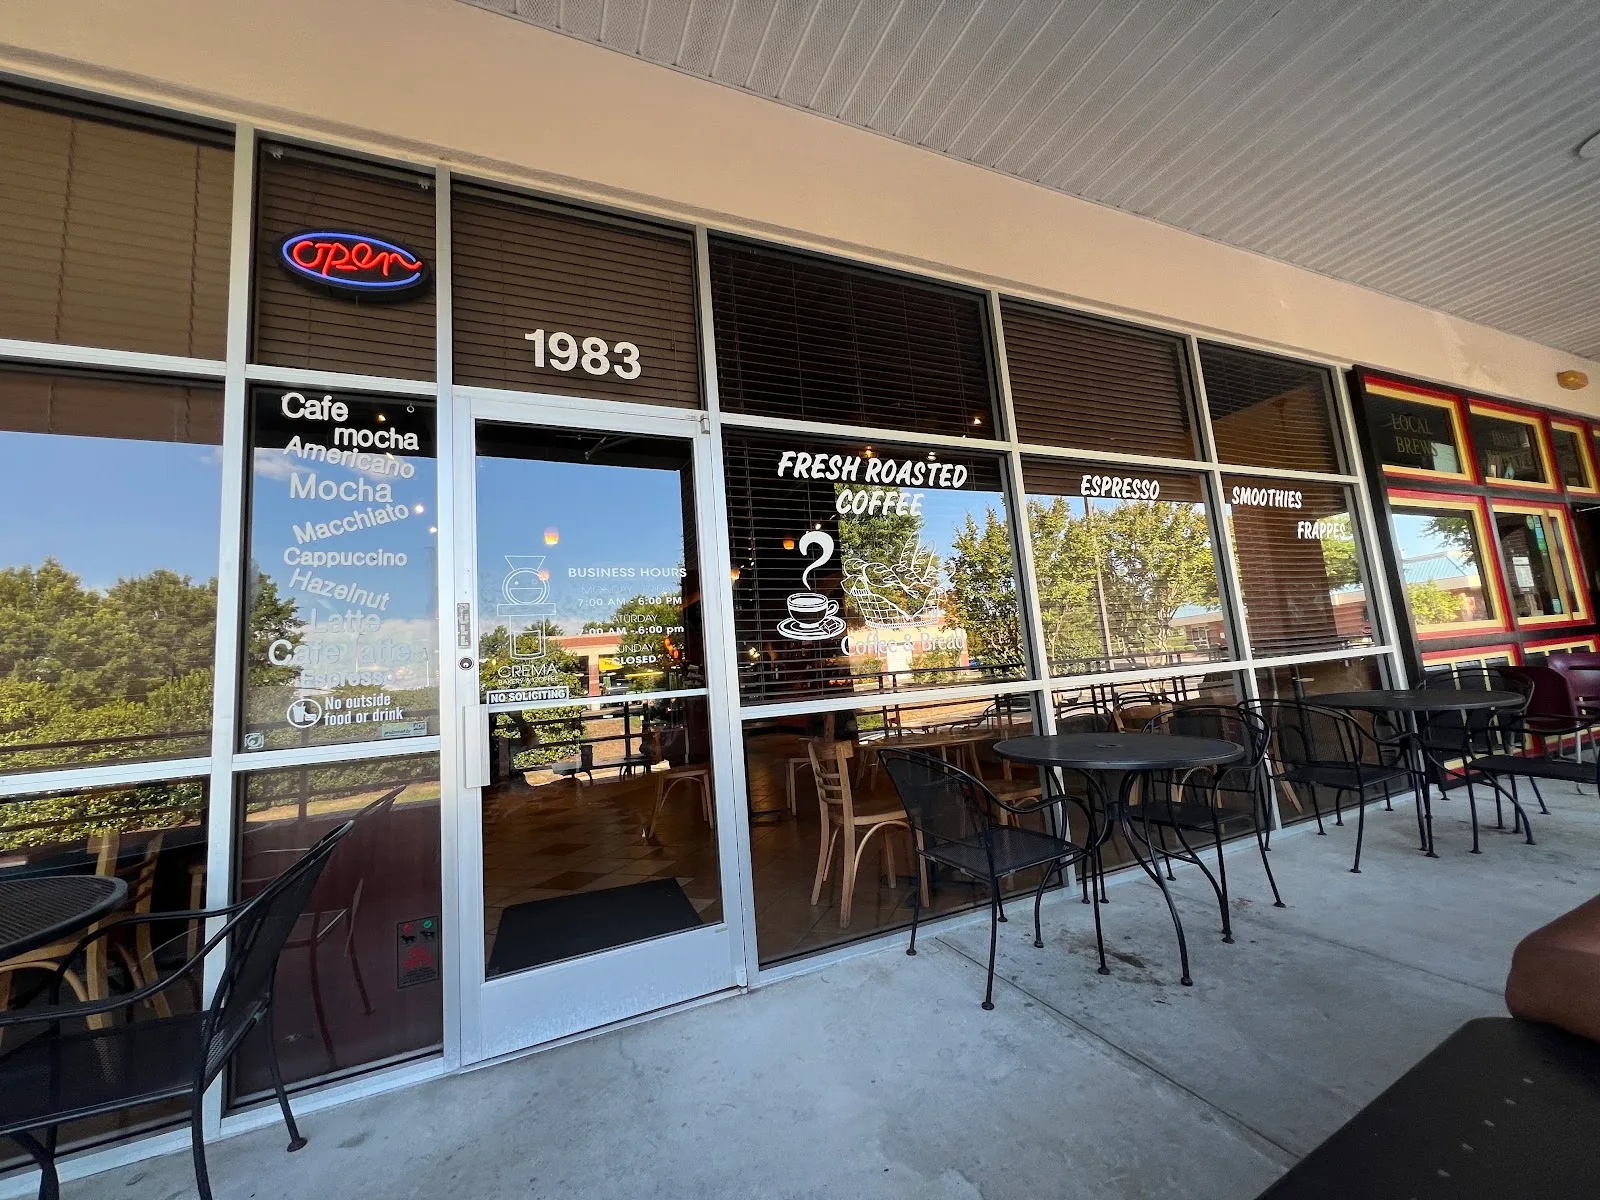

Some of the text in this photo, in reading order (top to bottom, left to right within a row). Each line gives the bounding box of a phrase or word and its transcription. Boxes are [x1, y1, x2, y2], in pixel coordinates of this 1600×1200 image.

[524, 328, 642, 381] 1983
[281, 392, 349, 422] Cafe
[1390, 412, 1433, 435] LOCAL
[334, 426, 420, 451] mocha
[1394, 435, 1439, 457] BREWS
[283, 435, 415, 479] Americano
[777, 450, 968, 489] FRESH ROASTED
[290, 472, 393, 503] Mocha
[1080, 474, 1160, 500] ESPRESSO
[1231, 485, 1302, 509] SMOOTHIES
[835, 489, 925, 516] COFFEE
[292, 503, 410, 545] Macchiato
[1297, 521, 1346, 540] FRAPPES
[283, 546, 408, 569] Cappuccino
[568, 567, 687, 578] BUSINESS HOURS
[288, 567, 391, 612] Hazelnut
[581, 585, 632, 594] MONDAY
[577, 598, 603, 607] 7:00
[607, 597, 626, 606] AM
[638, 596, 662, 605] 6:00
[666, 596, 683, 604] PM
[309, 608, 382, 634] Latte
[457, 603, 470, 647] PULL
[608, 614, 658, 623] ATURDAY
[608, 626, 627, 635] AM
[638, 625, 663, 634] 6:00
[667, 626, 685, 636] pm
[268, 638, 412, 666] Cafe atte
[841, 631, 966, 656] Coffee & Bread
[497, 662, 558, 678] CREMA
[611, 654, 657, 665] CLOSED
[300, 669, 397, 691] Espresso
[498, 678, 524, 686] BAKERY
[533, 675, 560, 683] COFFEE
[324, 693, 391, 710] No outside
[490, 689, 566, 703] NO SOLICITING
[323, 707, 403, 727] food or drink
